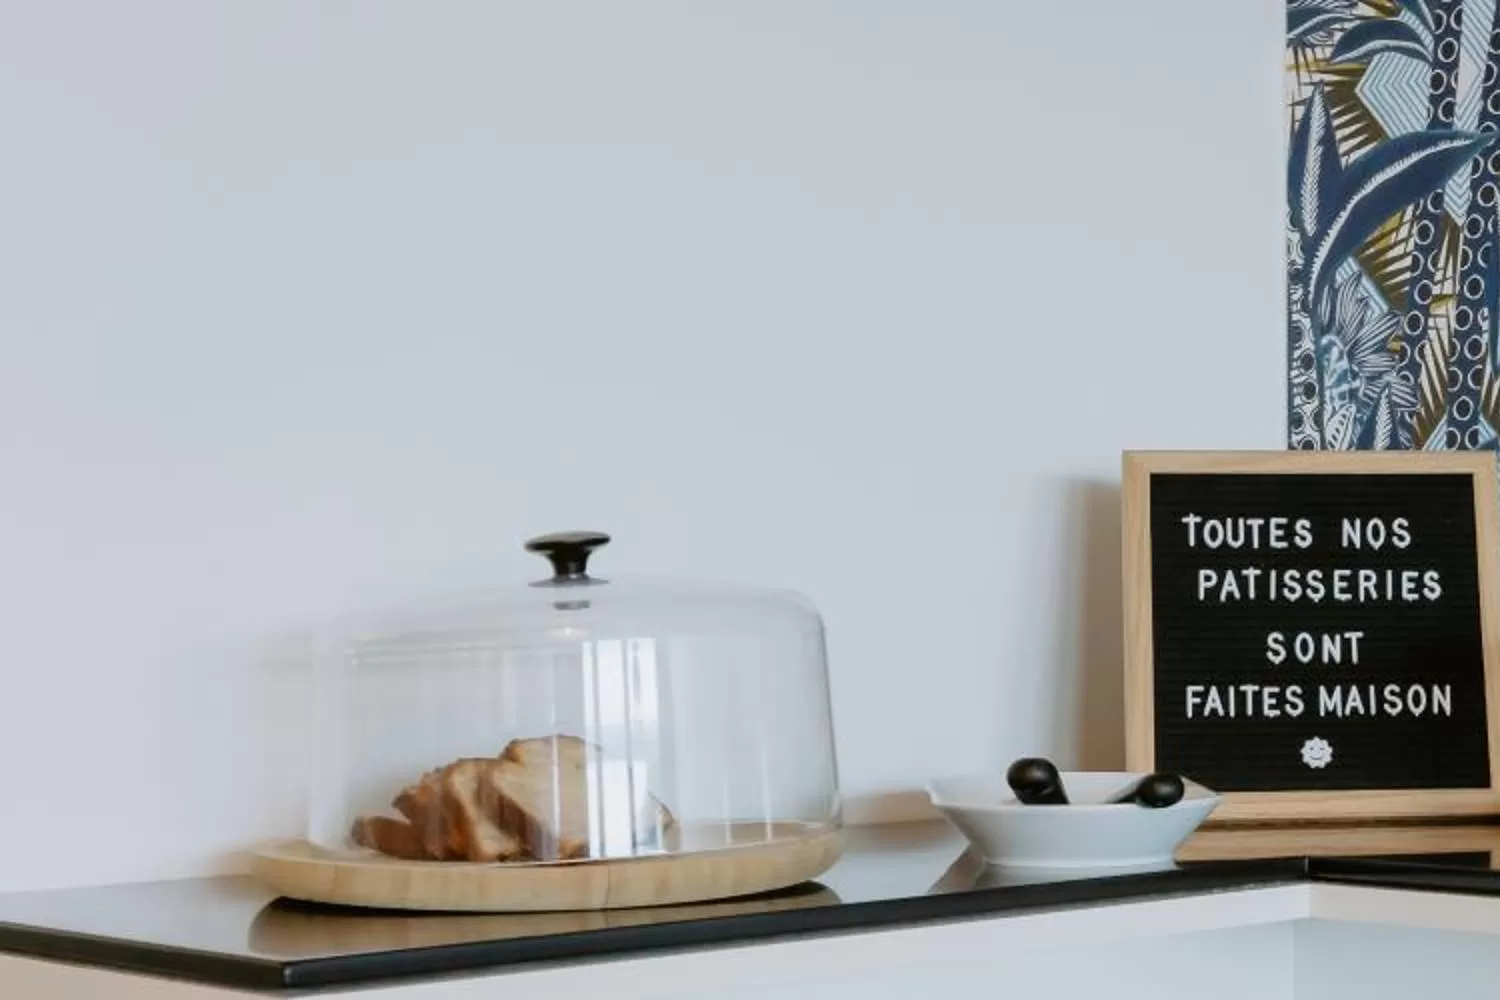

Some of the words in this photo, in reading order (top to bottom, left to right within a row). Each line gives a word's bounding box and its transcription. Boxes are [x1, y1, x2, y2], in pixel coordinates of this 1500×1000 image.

[1181, 512, 1313, 550] TOUTES
[1341, 517, 1412, 551] NOS
[1197, 566, 1443, 603] PATISSERIES
[1266, 631, 1364, 665] SONT
[1185, 683, 1305, 719] FAITES
[1318, 683, 1452, 718] MAISON
